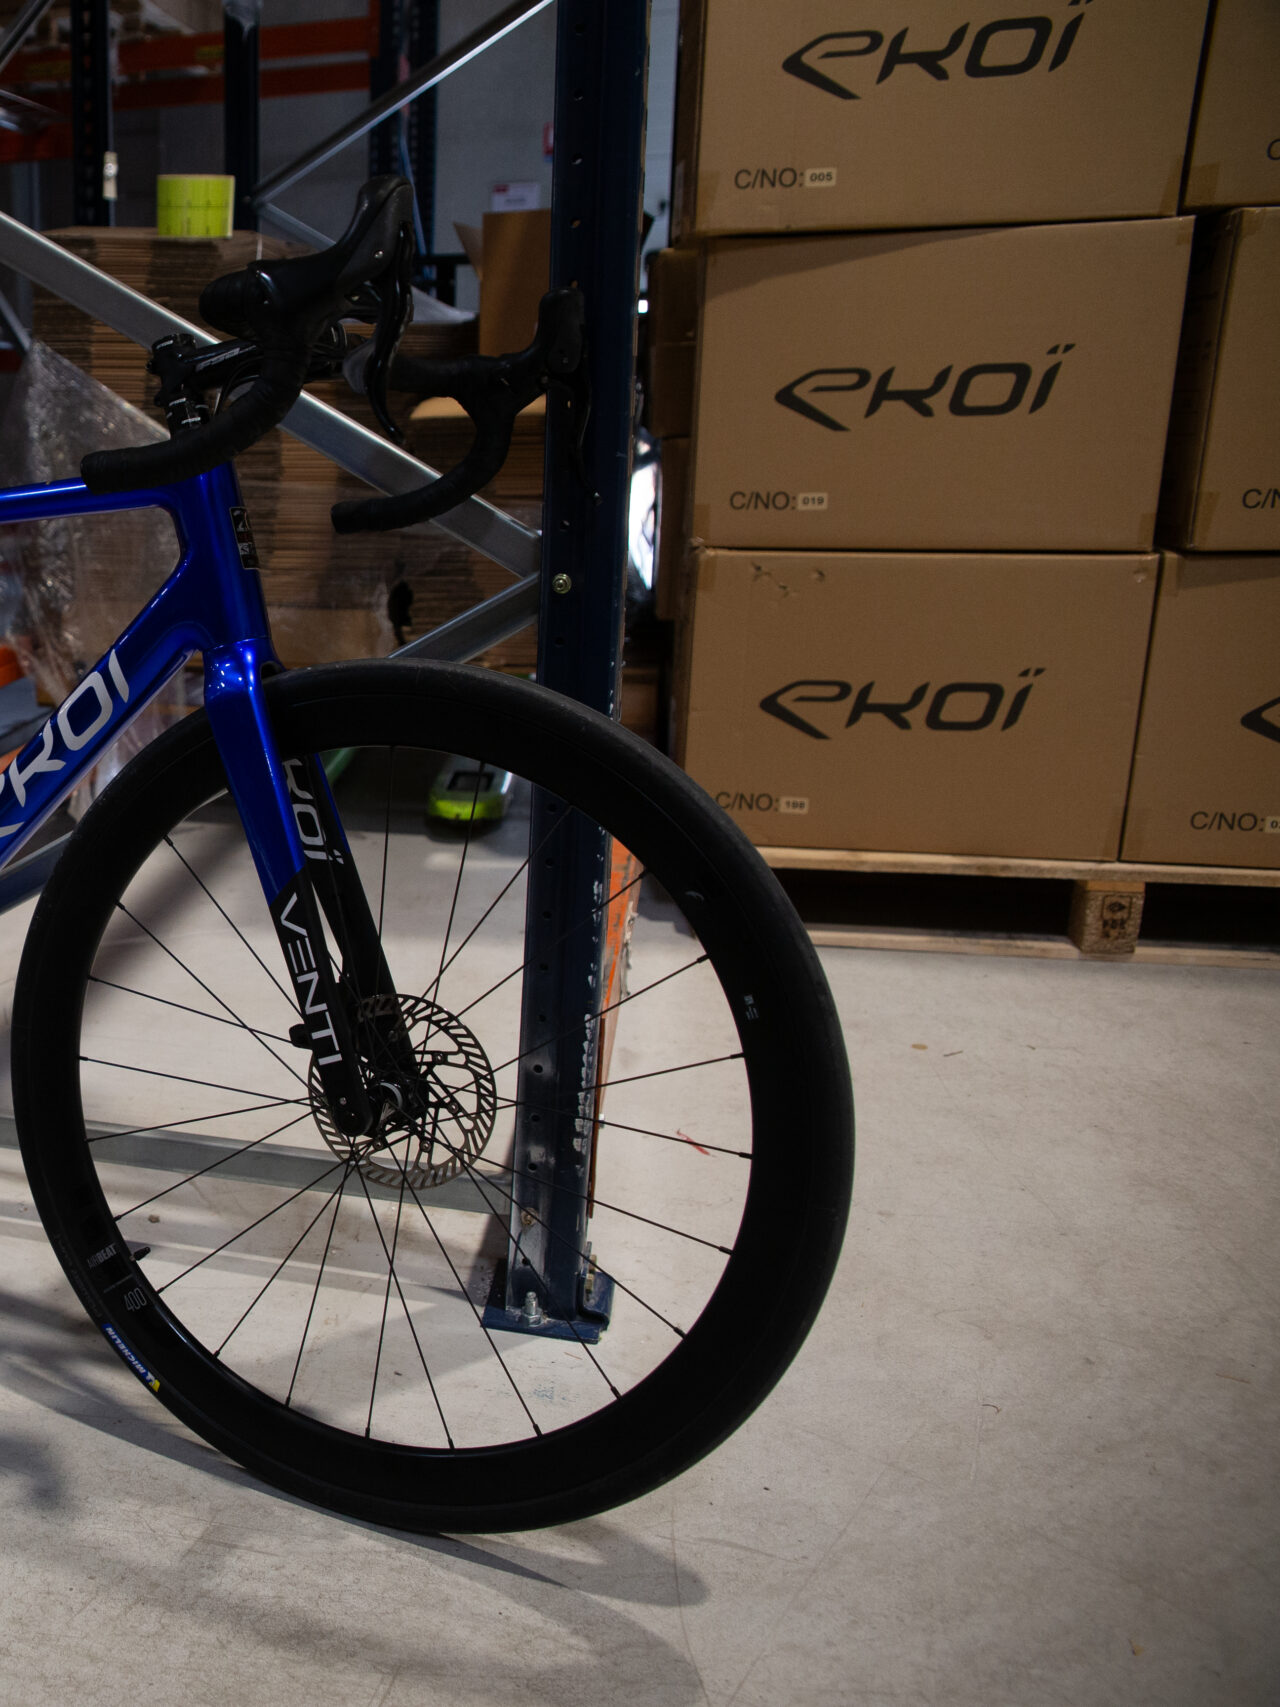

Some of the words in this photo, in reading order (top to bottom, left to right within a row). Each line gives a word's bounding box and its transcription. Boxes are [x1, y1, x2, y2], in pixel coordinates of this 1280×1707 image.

[734, 167, 804, 189] C/NO:
[809, 171, 833, 182] 005
[729, 491, 797, 511] C/NO:
[715, 791, 779, 812] C/NO:
[1190, 811, 1265, 832] C/NO:
[280, 891, 343, 1067] VENTI
[123, 1287, 147, 1312] 400
[104, 1325, 147, 1374] MICHELIN
